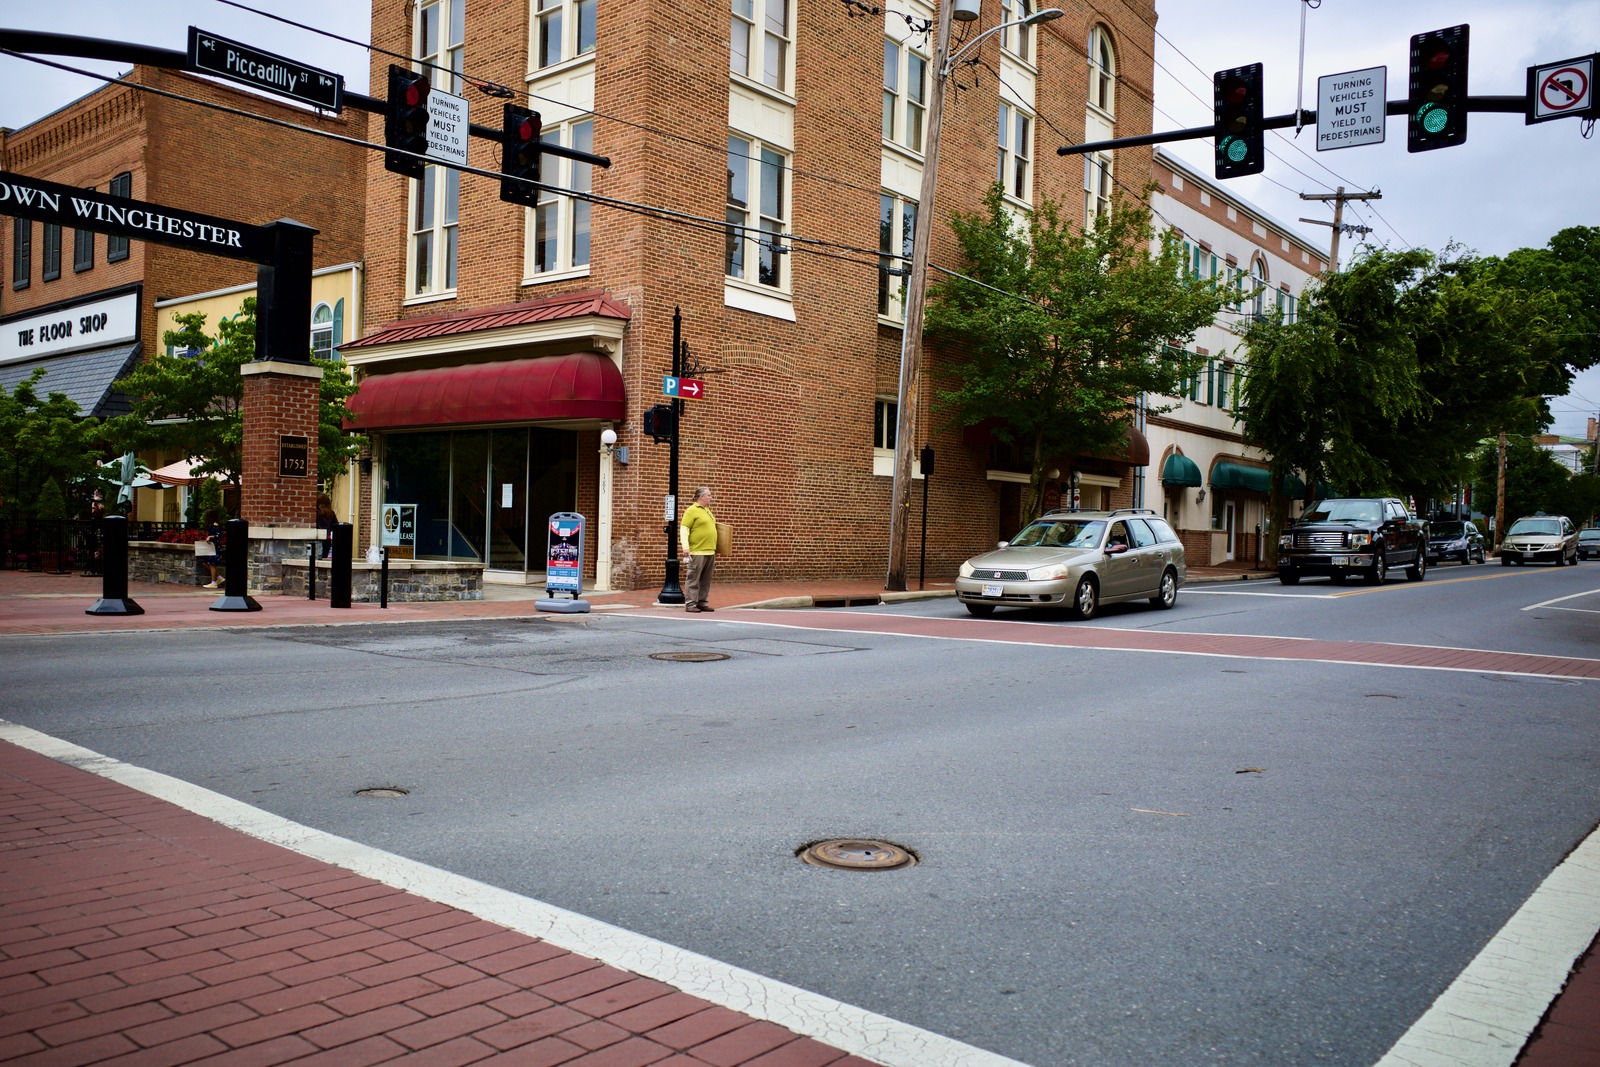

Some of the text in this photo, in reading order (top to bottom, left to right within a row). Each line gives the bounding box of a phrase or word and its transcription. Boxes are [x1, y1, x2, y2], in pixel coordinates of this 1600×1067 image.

[210, 40, 325, 92] E Piccadilly ST W
[1333, 78, 1371, 91] TURNING
[1330, 89, 1374, 103] VEHICLES
[432, 96, 459, 112] TURNING
[1335, 102, 1367, 116] MUST
[429, 106, 461, 123] VEHICLES
[1331, 115, 1372, 128] YIELD TO
[433, 118, 456, 133] MUST
[430, 130, 459, 145] YIELD TO
[1320, 126, 1381, 142] PEDESTRIANS
[427, 140, 465, 158] EDESTRIANS
[0, 181, 243, 248] OWN WINCHESTER
[18, 312, 108, 347] THE FLOOR SHOP
[666, 377, 676, 394] P
[281, 442, 308, 450] ESTABLISHED
[284, 458, 305, 470] 1752
[402, 520, 412, 528] FOR
[400, 532, 414, 540] LEASE
